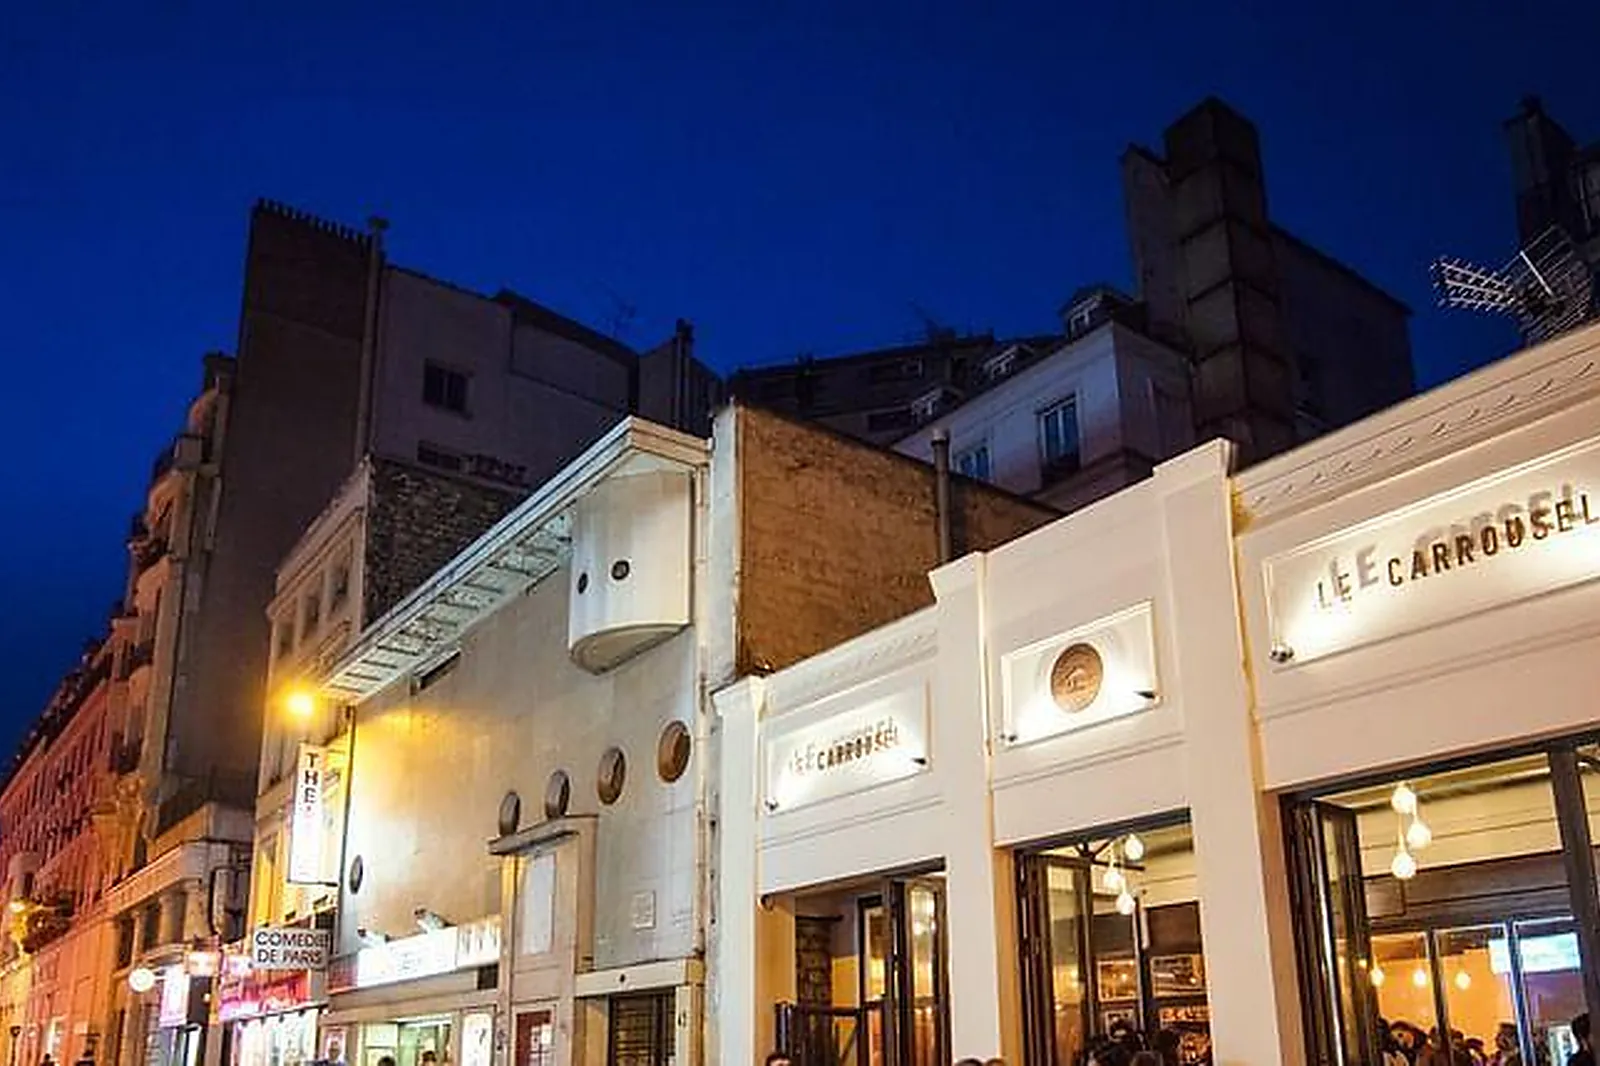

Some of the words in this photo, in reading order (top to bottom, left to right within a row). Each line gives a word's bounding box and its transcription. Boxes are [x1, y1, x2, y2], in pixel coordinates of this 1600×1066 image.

[1387, 492, 1600, 588] CARROUSEL
[817, 724, 900, 772] CARROUSEL
[257, 949, 277, 963] DE
[283, 949, 323, 964] PARIS
